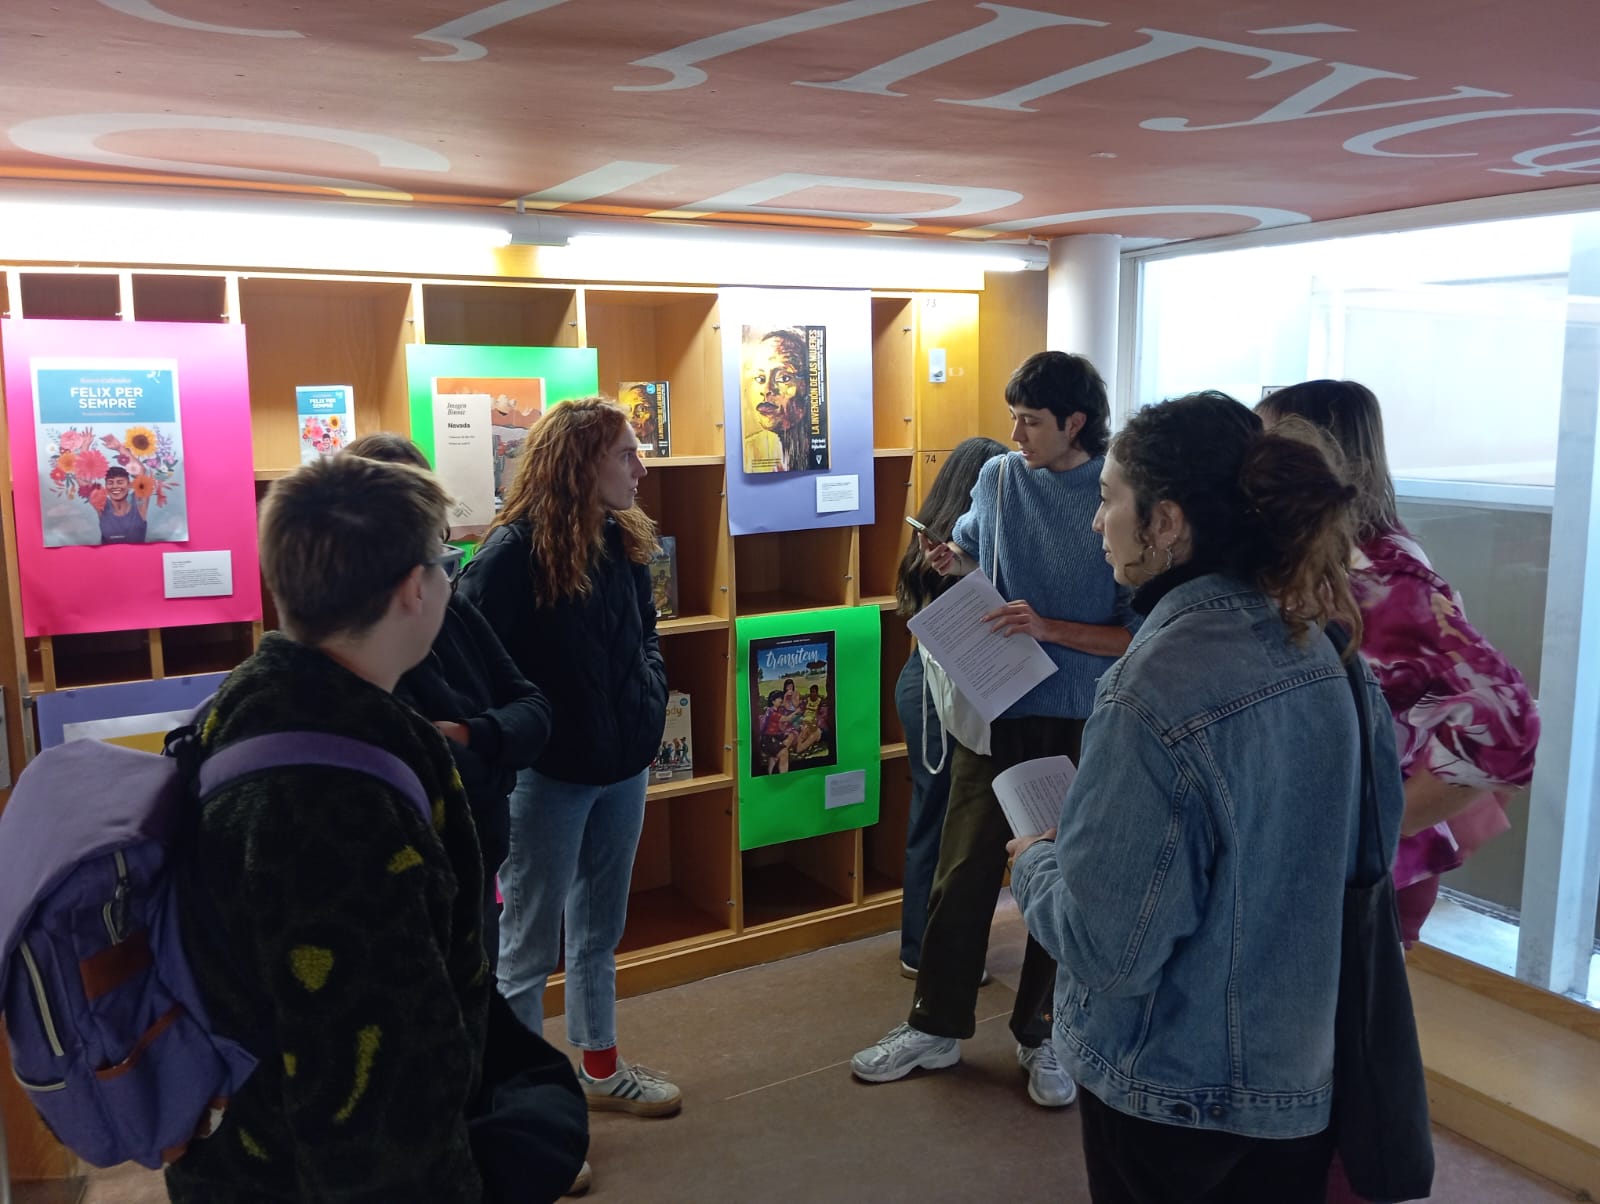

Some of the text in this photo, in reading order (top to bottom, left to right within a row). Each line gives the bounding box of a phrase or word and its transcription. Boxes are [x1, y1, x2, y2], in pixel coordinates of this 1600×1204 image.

[70, 387, 143, 398] FELIX PER
[79, 398, 136, 409] SEMPRE
[925, 455, 937, 465] 74
